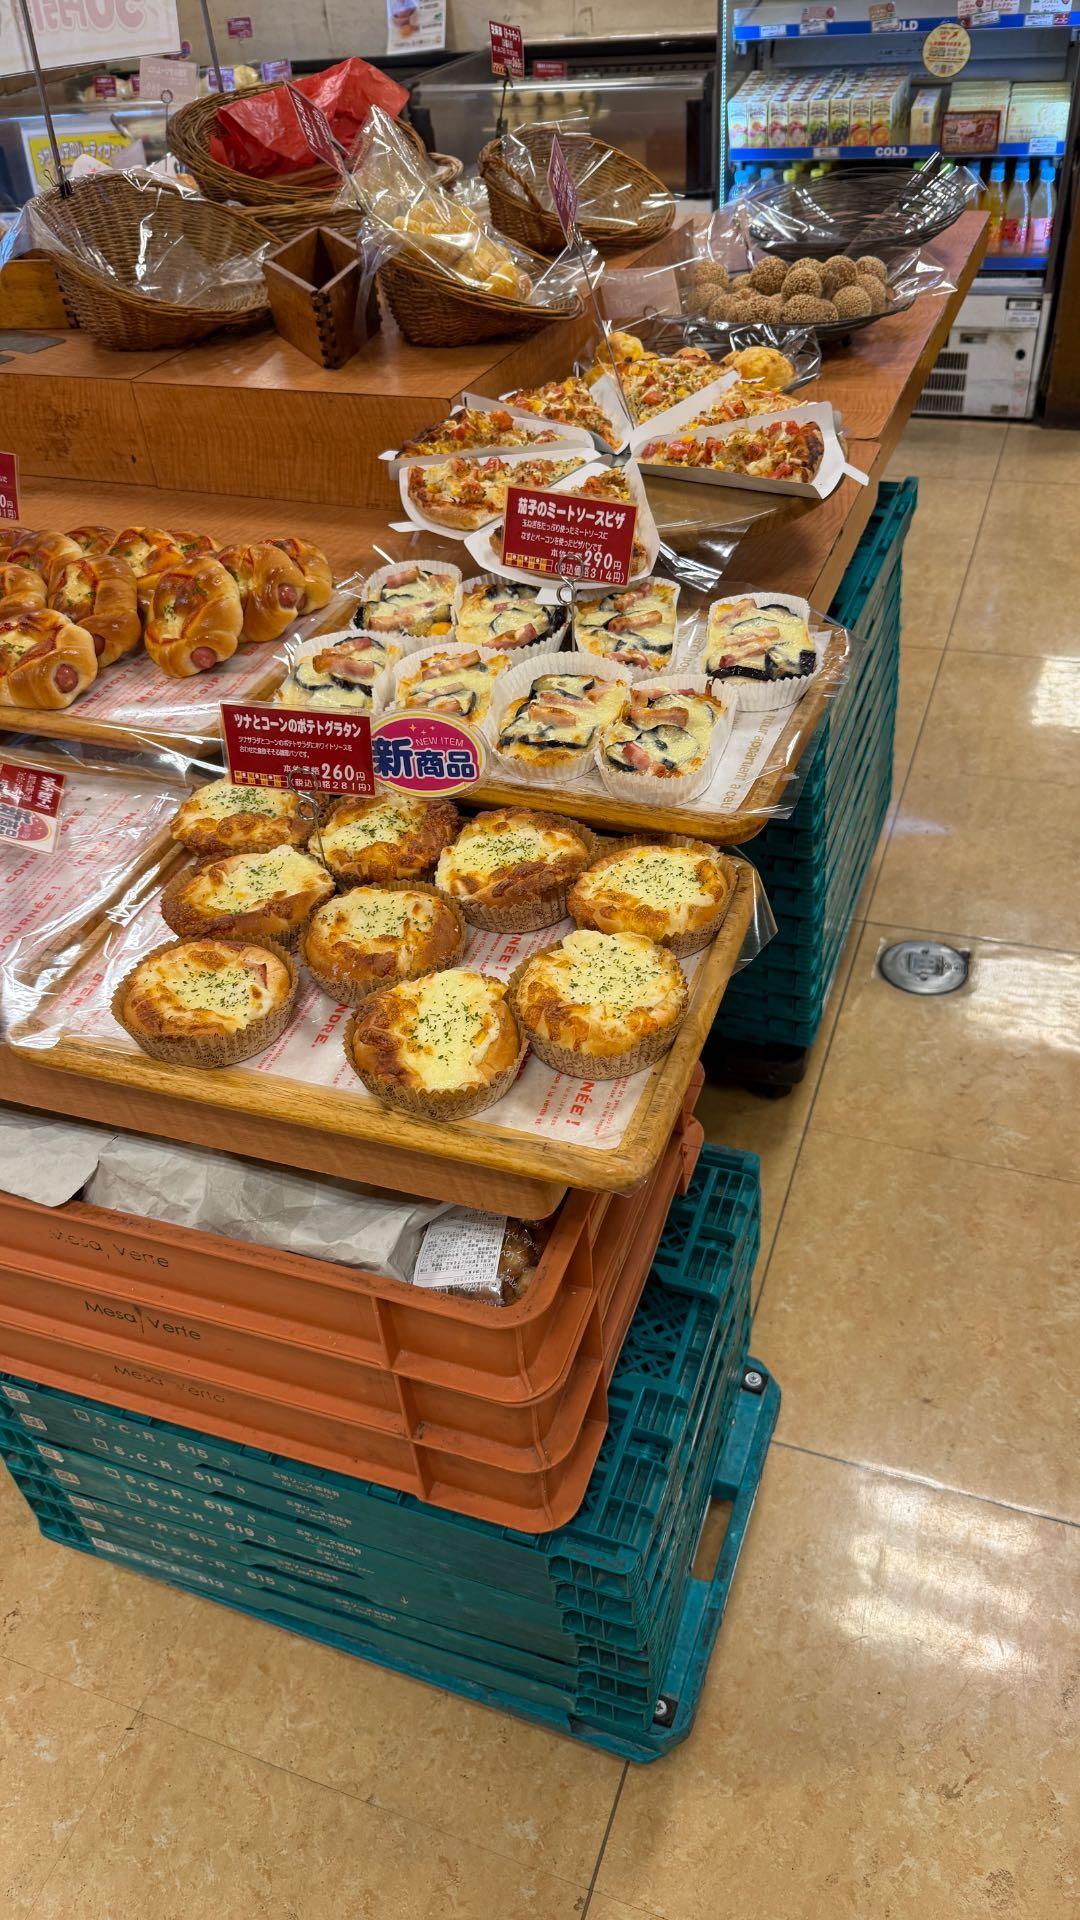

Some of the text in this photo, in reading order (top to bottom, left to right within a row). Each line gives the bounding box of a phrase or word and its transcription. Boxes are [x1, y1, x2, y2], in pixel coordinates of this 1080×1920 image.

[875, 147, 908, 157] COLD
[518, 497, 626, 530] 茄子のミートソースピザ
[233, 713, 361, 738] ツナとコーンのポテトグラタン
[415, 736, 464, 747] NEW ITEM
[372, 737, 476, 778] 新商品
[84, 1300, 201, 1340] Mesa Verte
[113, 1364, 165, 1386] Mesa
